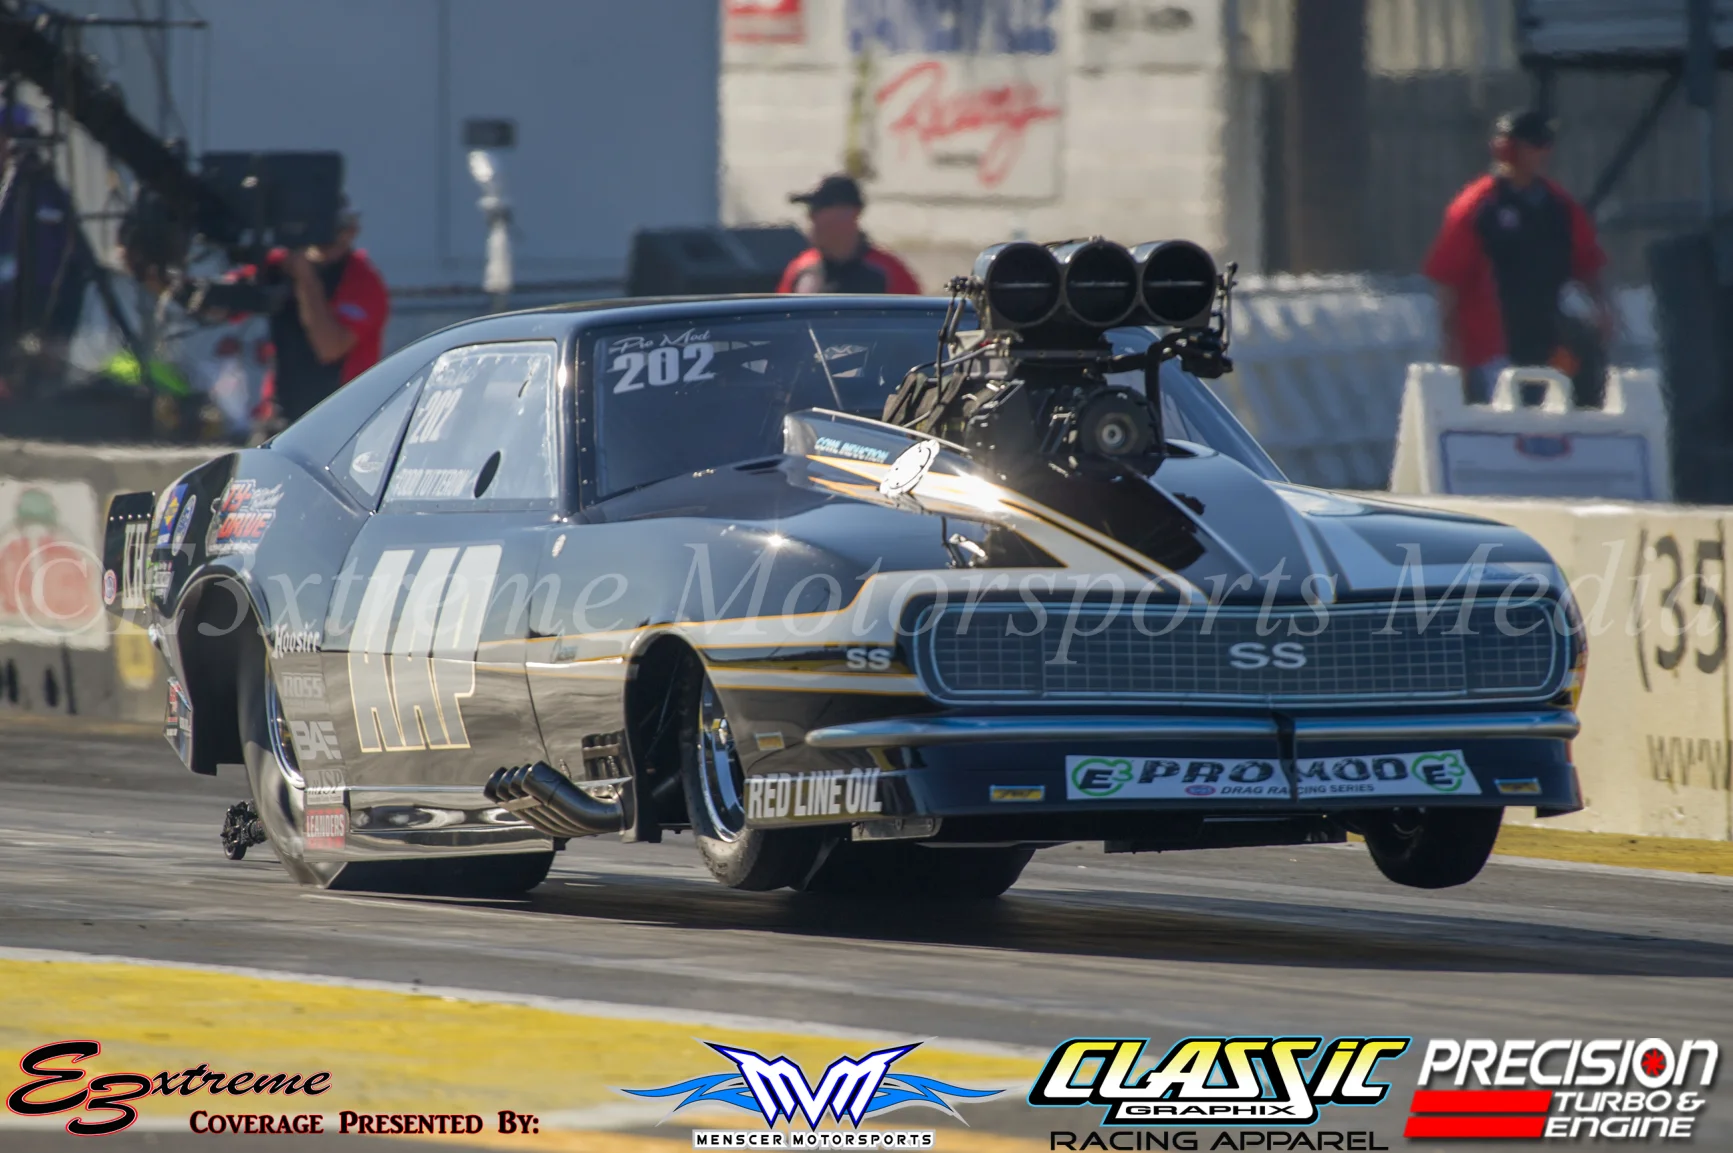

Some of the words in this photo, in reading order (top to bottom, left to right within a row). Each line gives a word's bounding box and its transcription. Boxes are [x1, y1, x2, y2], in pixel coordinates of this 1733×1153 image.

[608, 336, 654, 354] Pro
[660, 328, 710, 347] Mod
[606, 342, 717, 394] 202
[408, 388, 463, 444] 202
[814, 436, 842, 454] COWL
[217, 512, 273, 538] DRIVE
[272, 623, 321, 659] Hoosier
[846, 648, 891, 671] SS
[1228, 642, 1306, 670] SS
[289, 720, 343, 760] BAE
[1137, 760, 1274, 784] PRO
[1297, 757, 1409, 782] MOD
[748, 775, 792, 819] RED
[794, 770, 845, 817] LINE
[845, 767, 882, 814] OIL
[1220, 786, 1263, 795] DRAG
[1266, 784, 1327, 795] RACING
[1330, 783, 1375, 794] SERIES
[306, 813, 345, 838] LEANDERS
